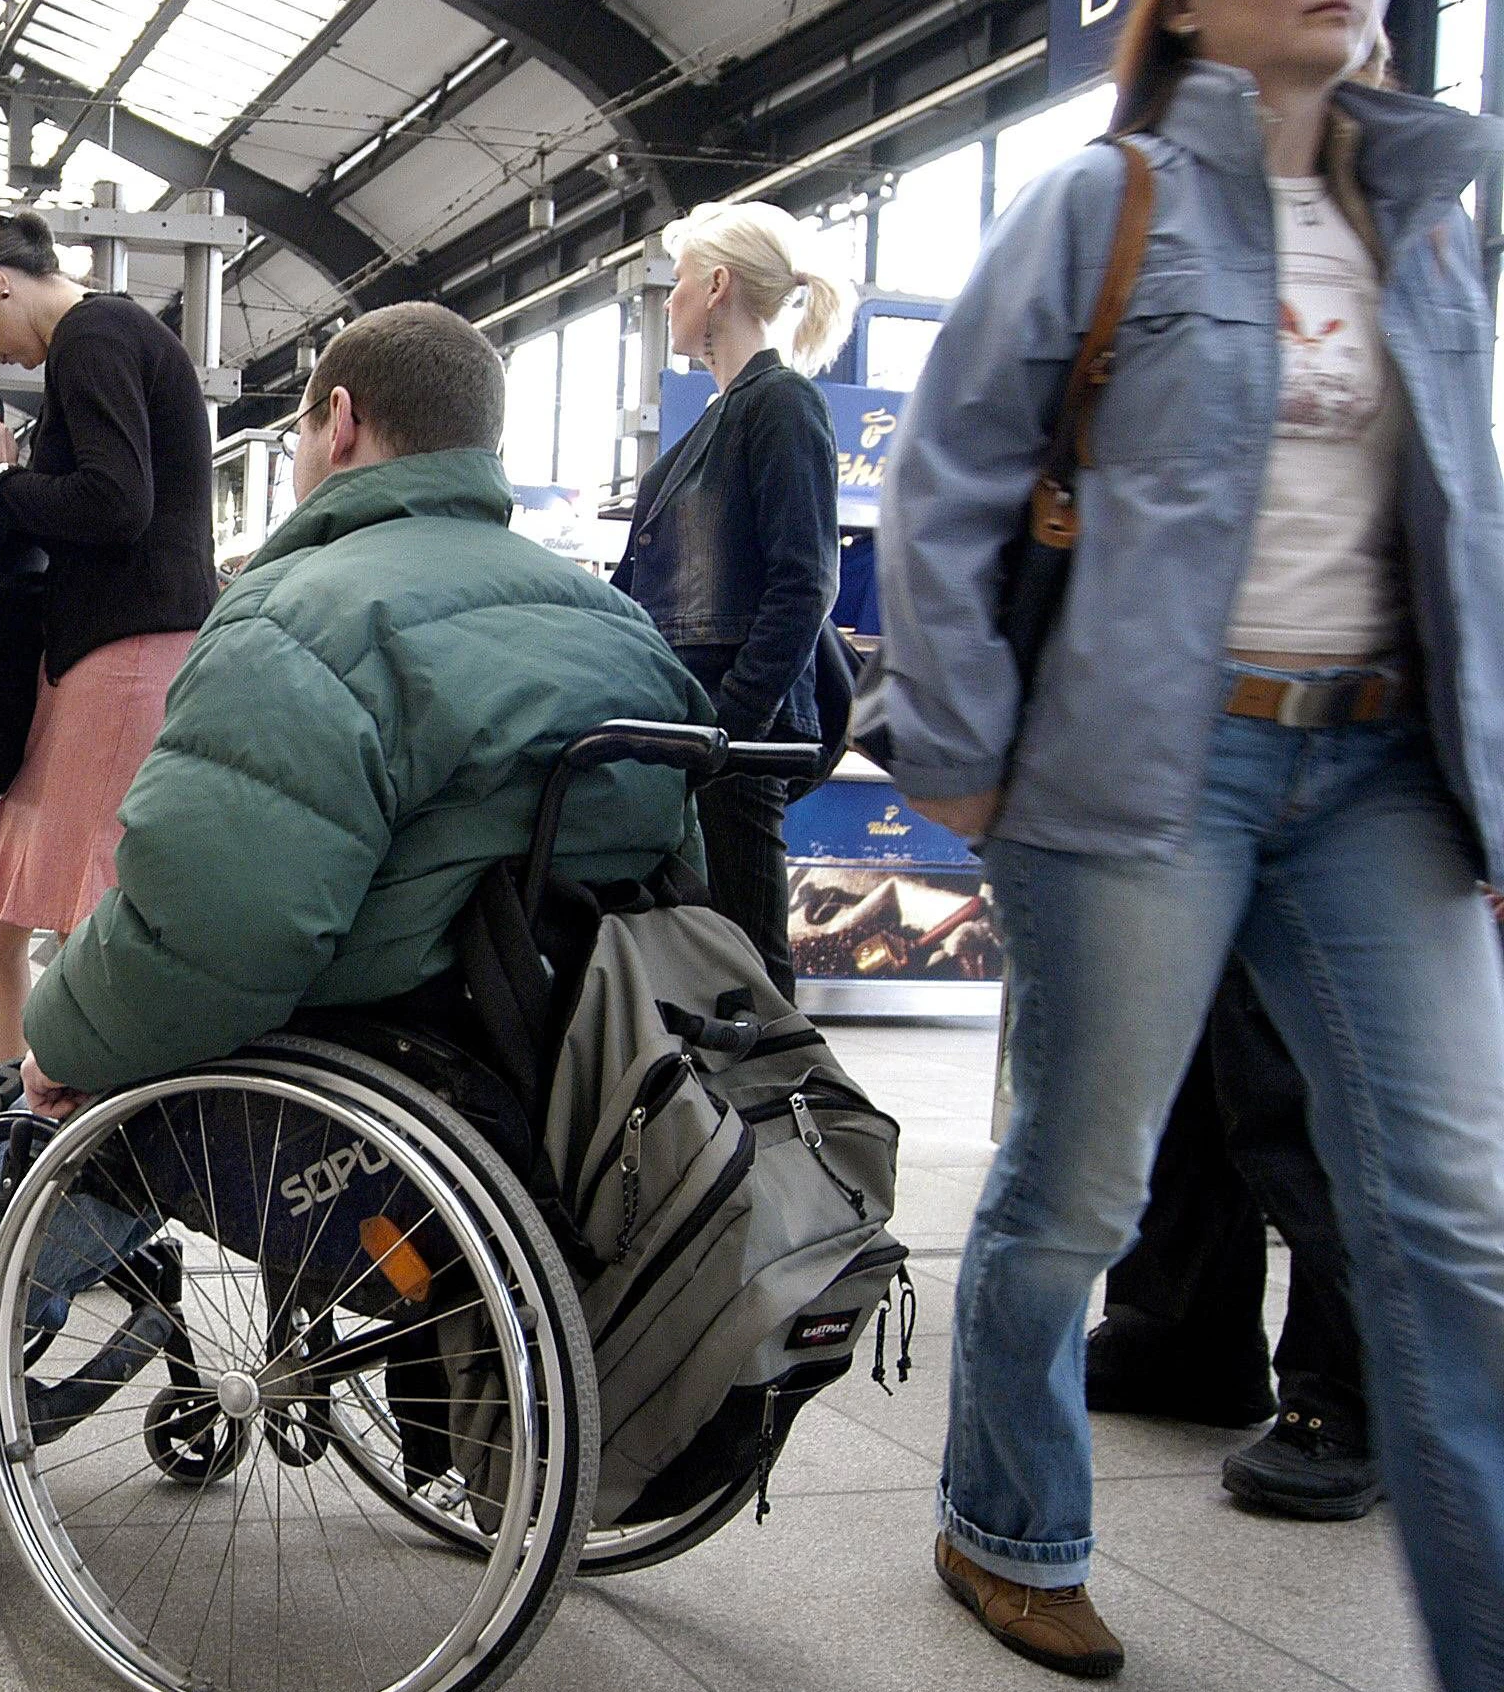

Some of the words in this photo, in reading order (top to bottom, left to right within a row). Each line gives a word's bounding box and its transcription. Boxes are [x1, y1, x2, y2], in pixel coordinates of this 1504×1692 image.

[542, 538, 584, 551] Tchibo
[867, 821, 912, 835] Tchibo
[280, 1139, 392, 1217] SOPU
[802, 1322, 850, 1338] EASTPAK
